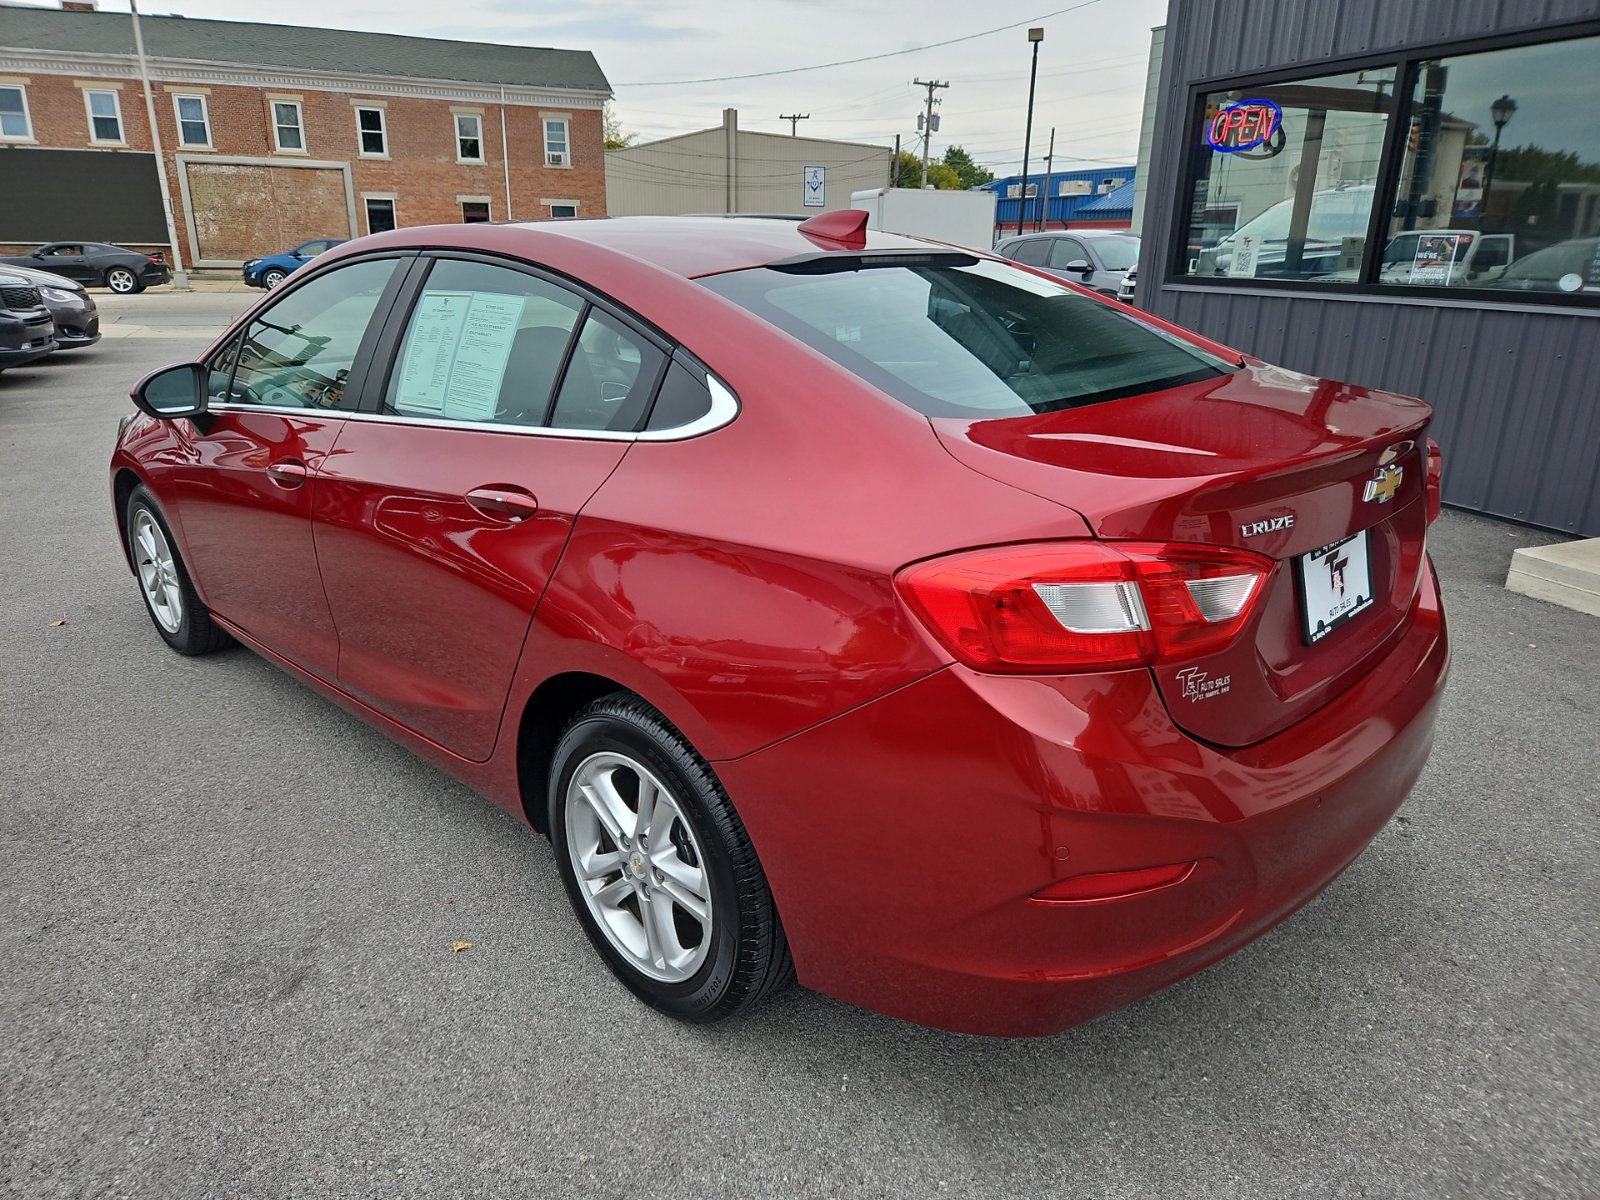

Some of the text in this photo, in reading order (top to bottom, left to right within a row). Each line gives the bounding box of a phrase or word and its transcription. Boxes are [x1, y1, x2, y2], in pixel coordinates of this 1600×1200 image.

[1210, 107, 1277, 144] OPEN
[1417, 252, 1438, 260] WE'RE
[1241, 515, 1294, 537] CRUZE
[1328, 607, 1339, 619] AUTO
[1339, 597, 1352, 613] SALES
[1200, 675, 1231, 693] AUTO SALES
